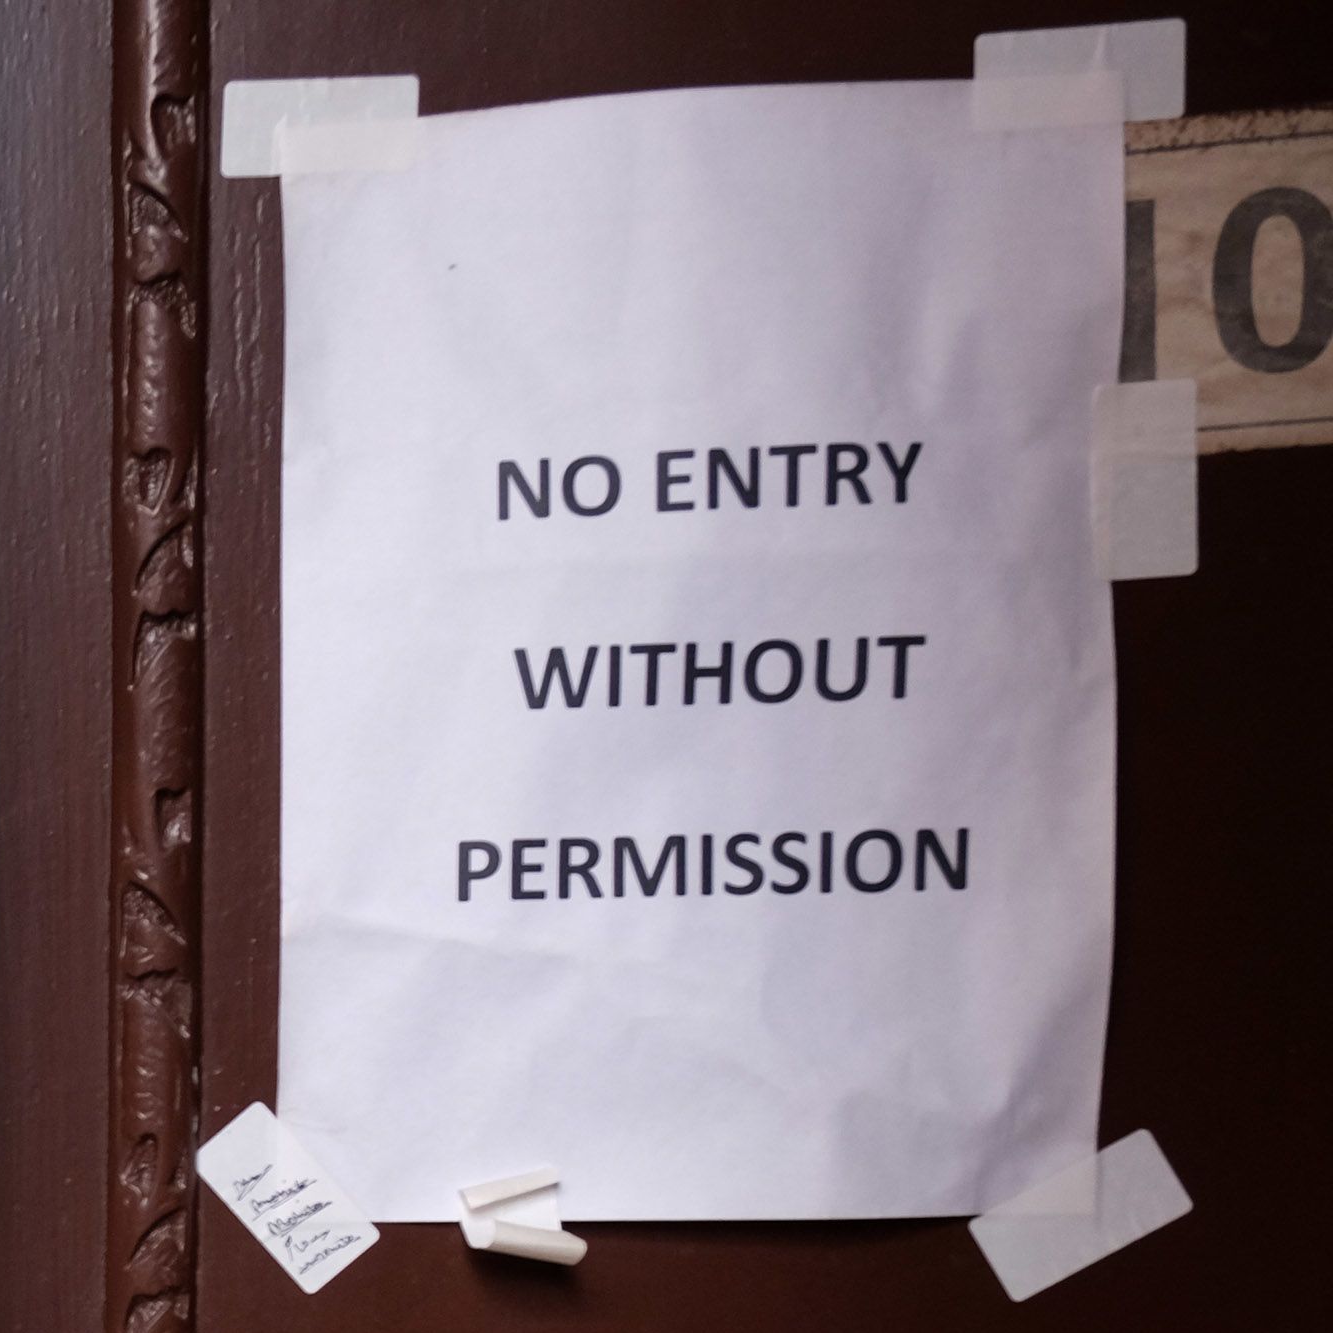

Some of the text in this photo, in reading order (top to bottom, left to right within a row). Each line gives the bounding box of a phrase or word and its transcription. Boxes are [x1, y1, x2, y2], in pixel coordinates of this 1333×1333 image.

[498, 440, 924, 522] NO ENTRY
[513, 633, 928, 711] WITHOUT
[457, 826, 971, 903] PERMISSION
